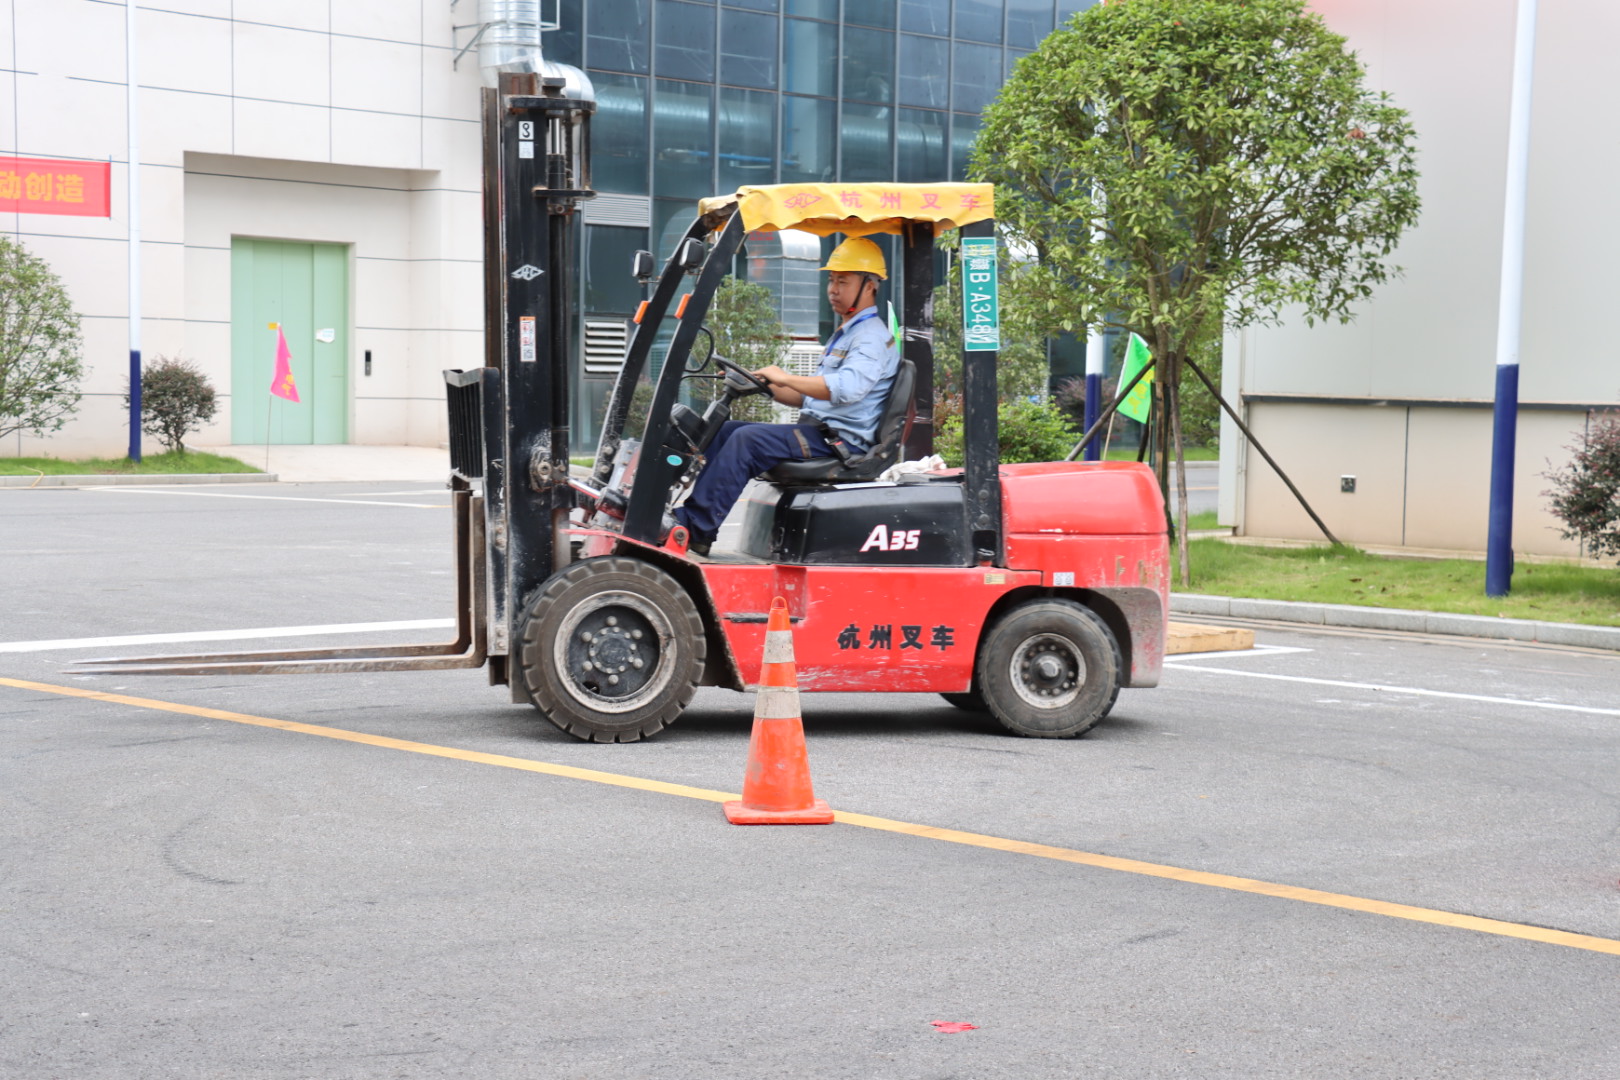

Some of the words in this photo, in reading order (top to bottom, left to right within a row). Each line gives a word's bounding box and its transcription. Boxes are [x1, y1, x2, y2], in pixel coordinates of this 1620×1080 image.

[0, 171, 84, 203] 动创造
[840, 190, 982, 212] 杭州叉车
[859, 524, 921, 552] A35
[836, 623, 955, 651] 杭州叉车
